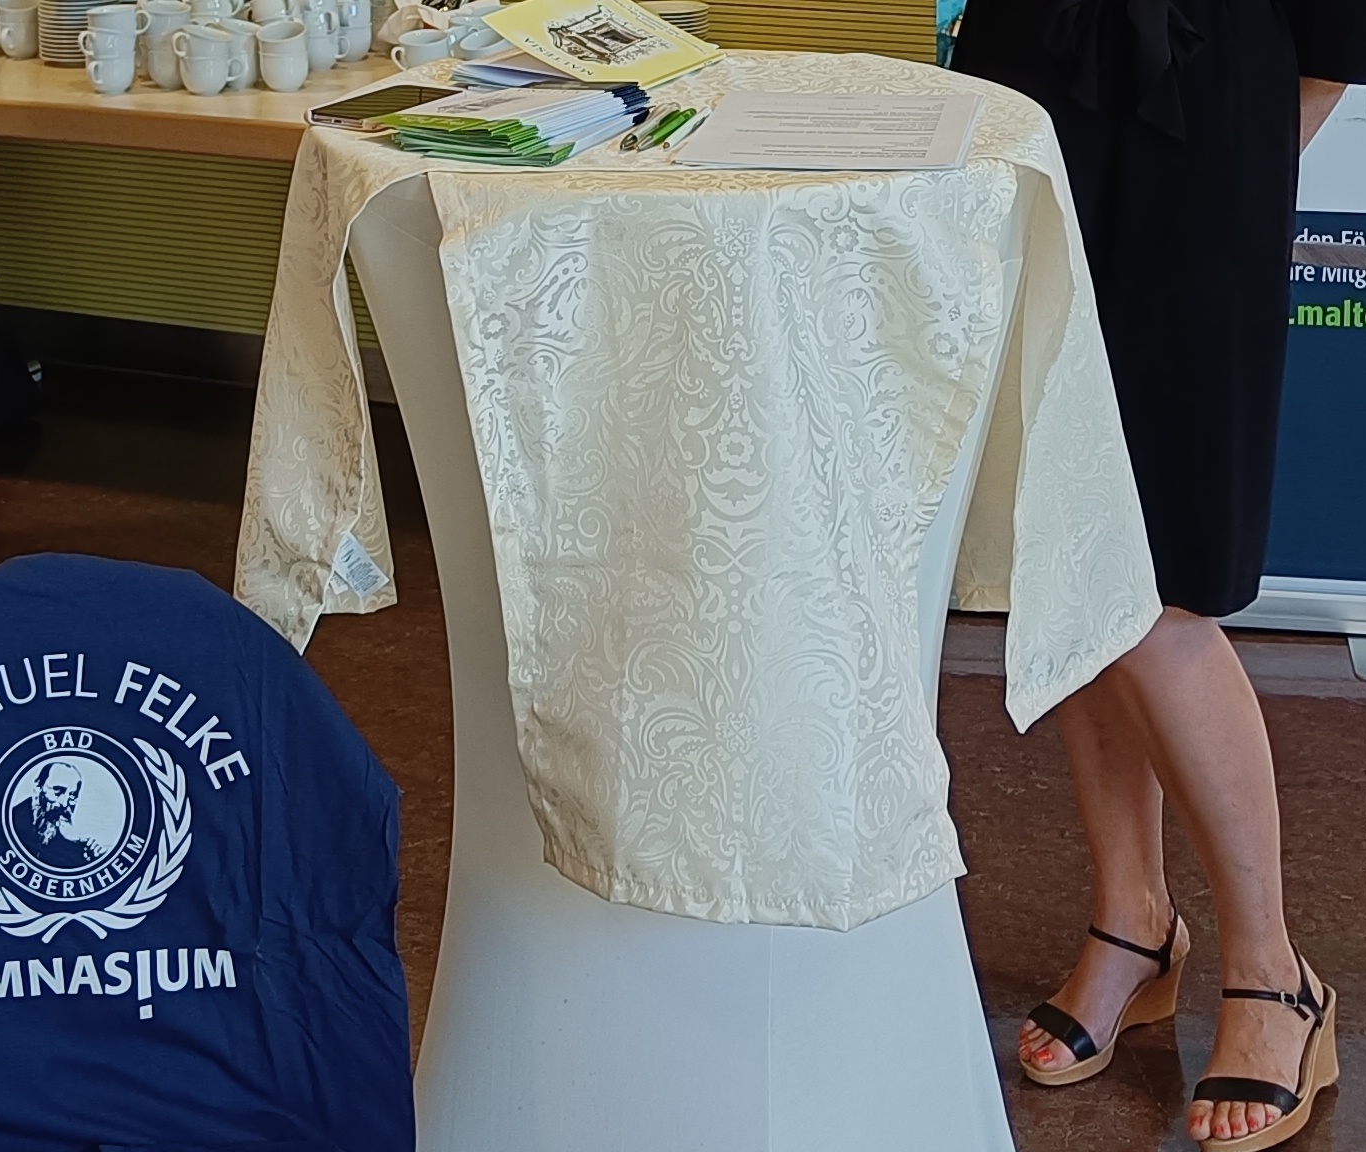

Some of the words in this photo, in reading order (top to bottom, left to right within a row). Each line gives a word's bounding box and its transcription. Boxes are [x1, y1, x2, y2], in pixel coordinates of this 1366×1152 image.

[42, 730, 94, 750] BAD
[114, 661, 251, 791] FELKE
[0, 833, 146, 899] SOBERNHEIM
